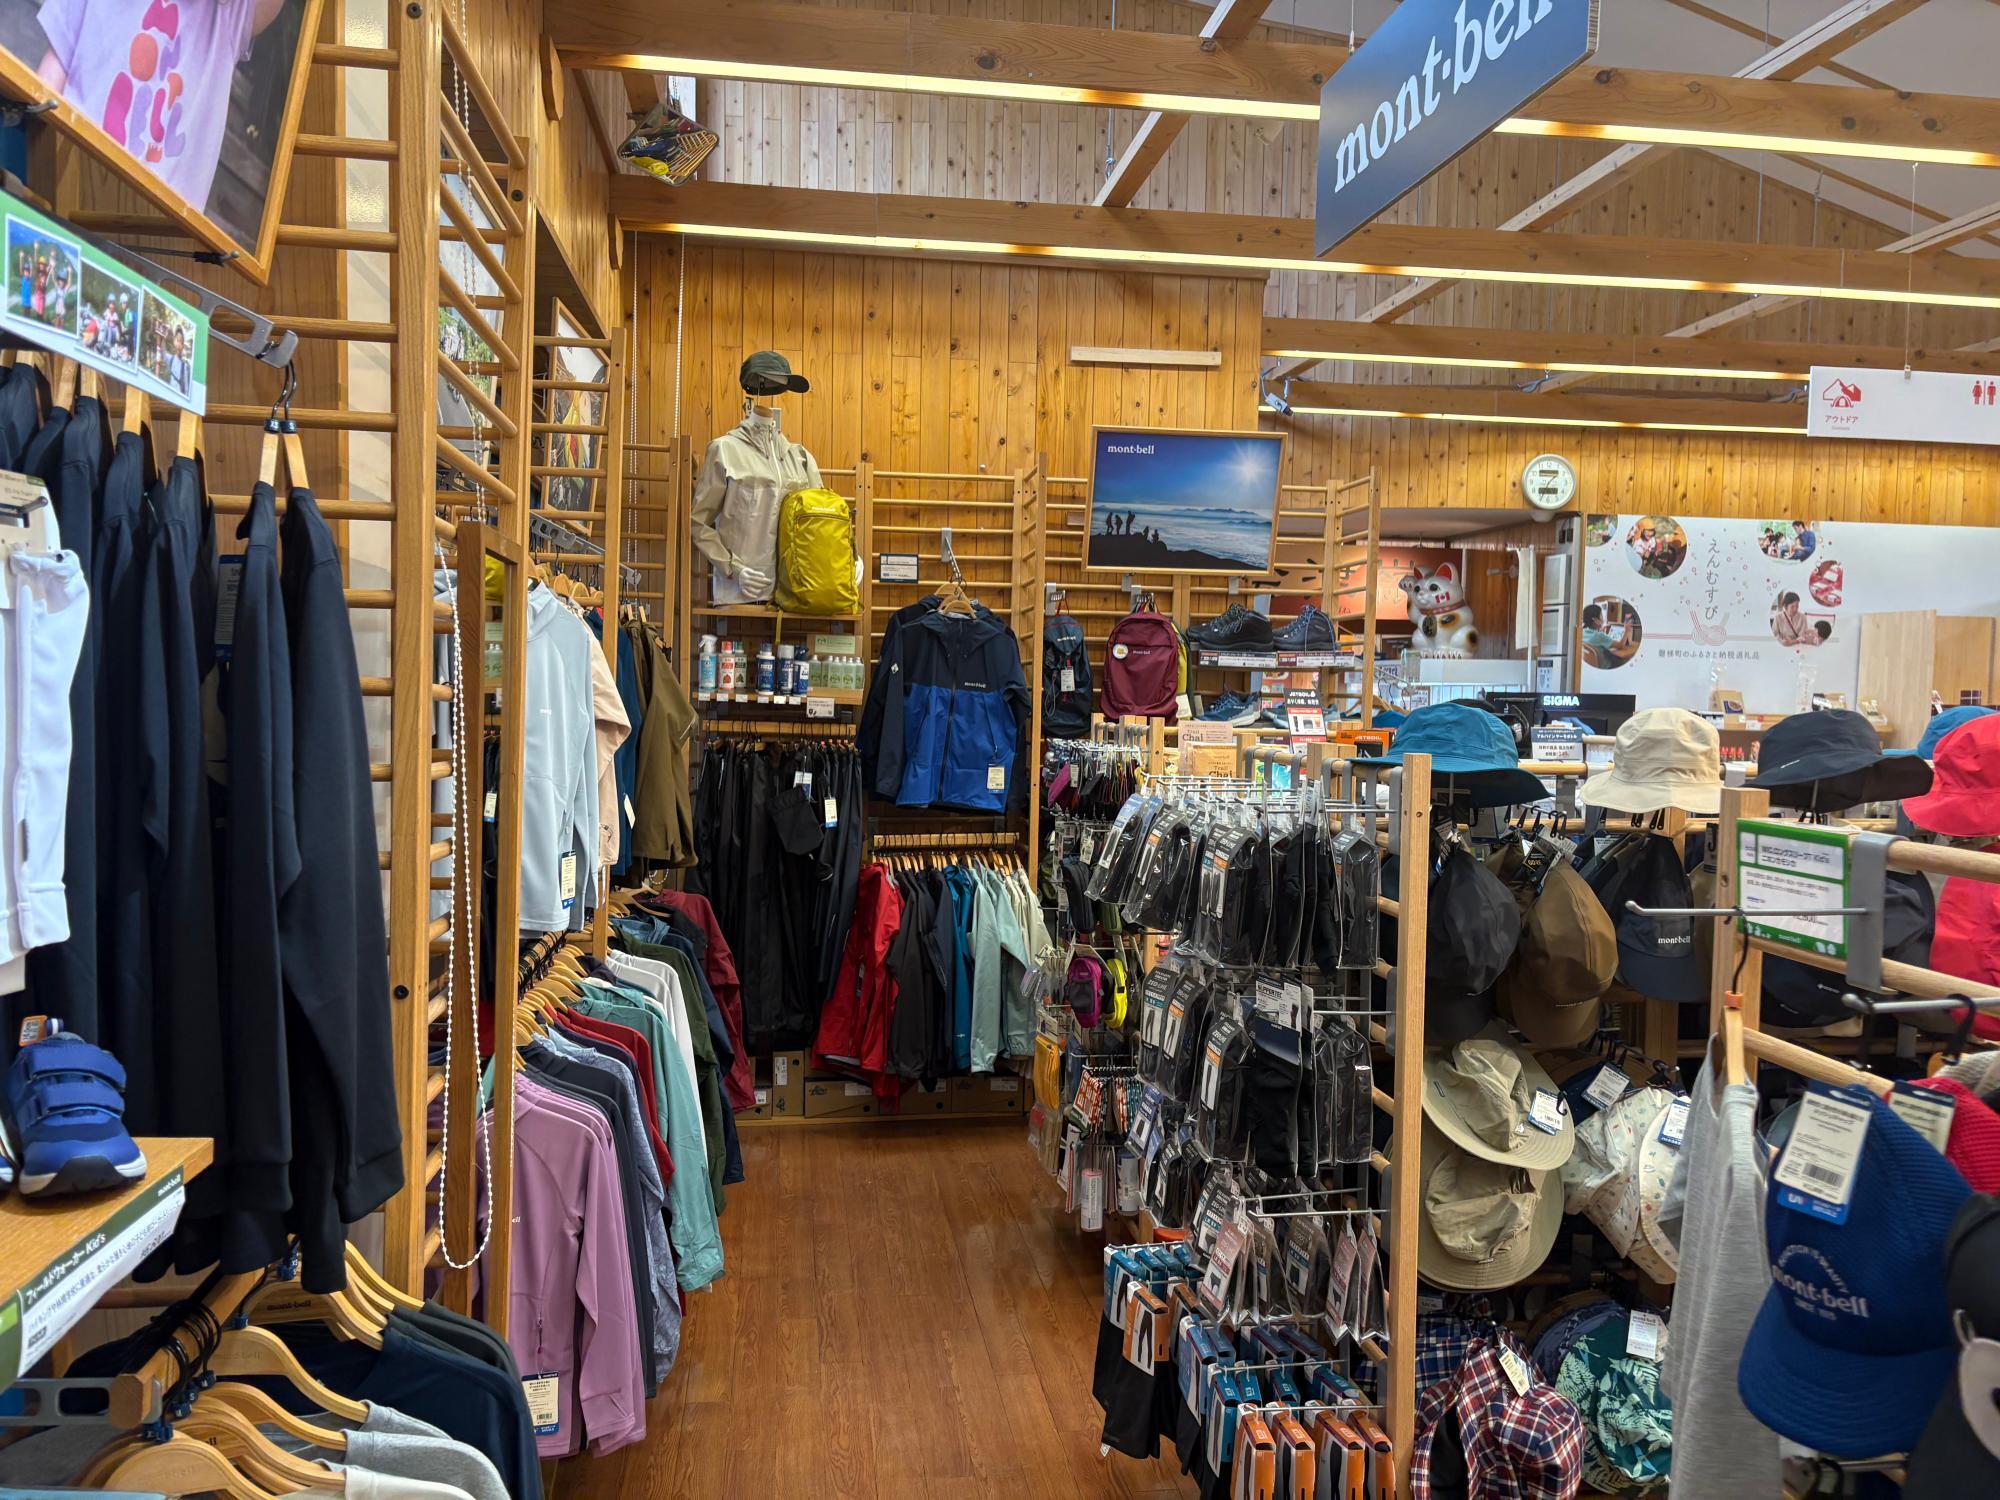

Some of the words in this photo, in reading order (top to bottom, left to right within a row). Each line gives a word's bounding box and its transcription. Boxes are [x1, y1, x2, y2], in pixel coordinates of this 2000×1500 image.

[1824, 414, 1860, 425] アウトドア
[1705, 538, 1720, 620] えんむすび
[1543, 695, 1580, 706] SIGMA
[25, 1251, 86, 1305] フィールドウォーカー
